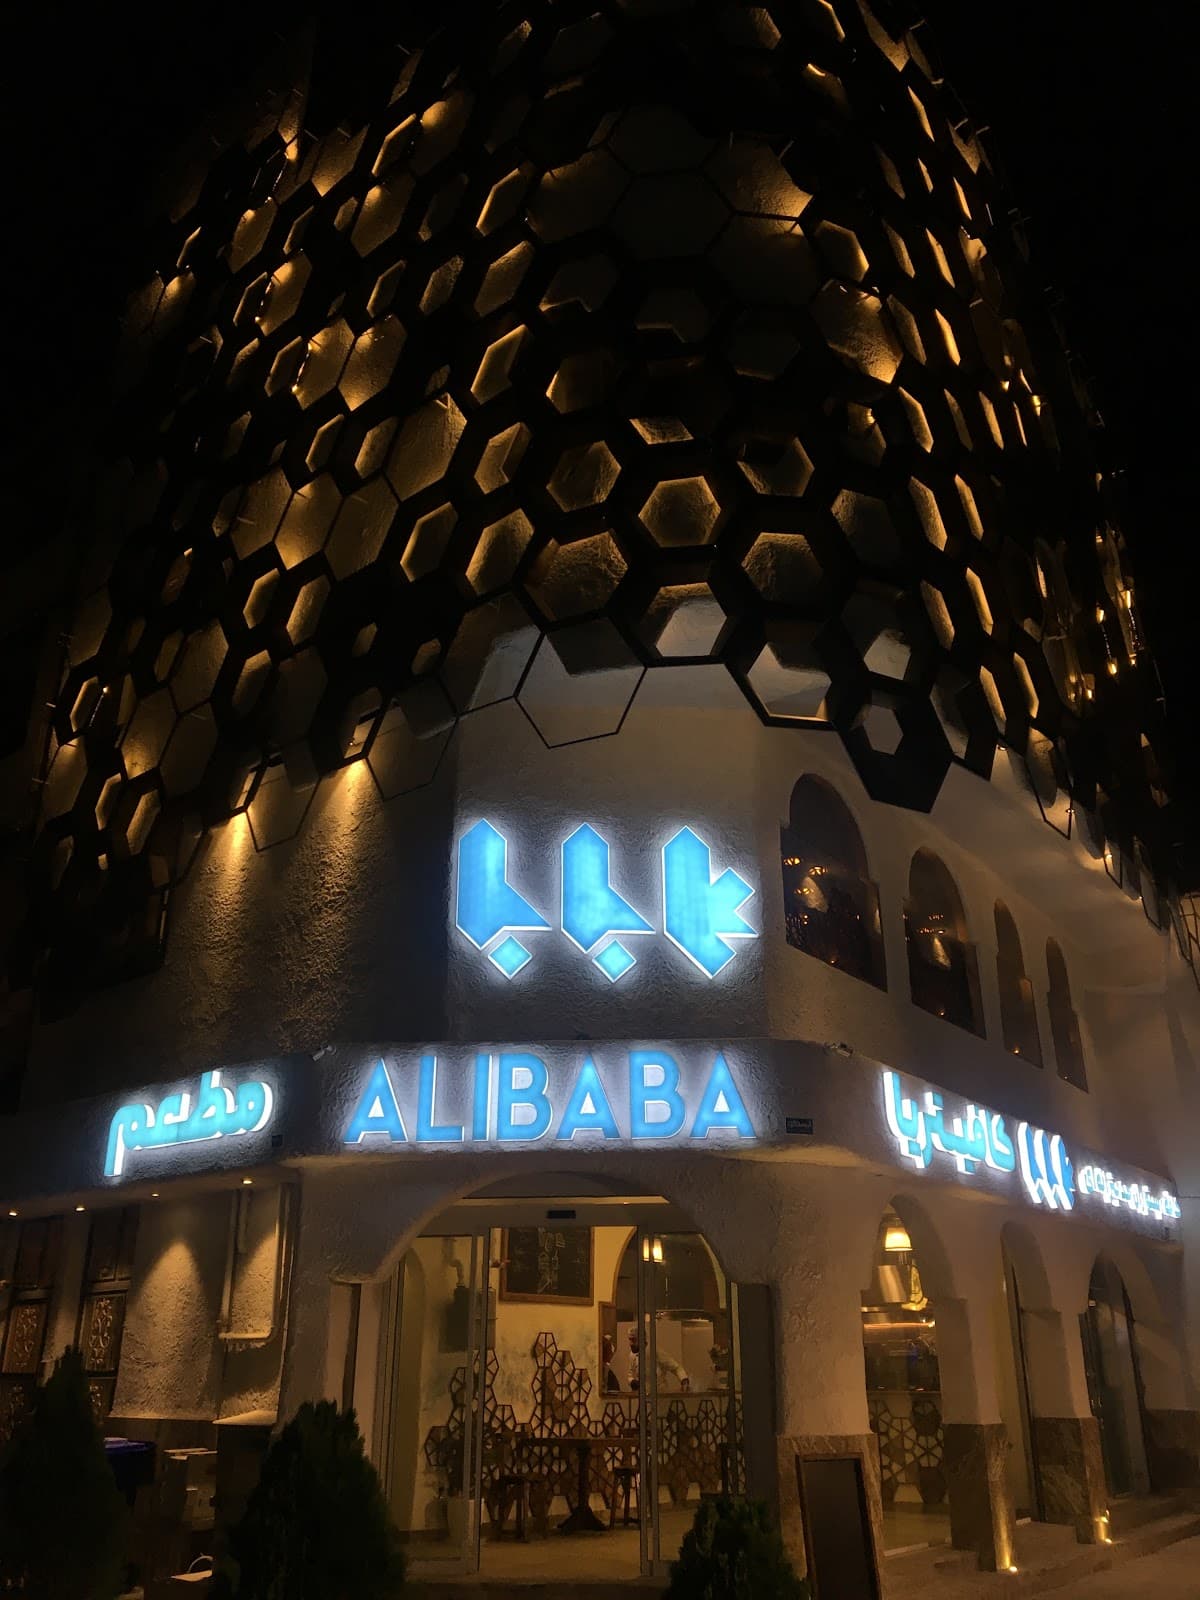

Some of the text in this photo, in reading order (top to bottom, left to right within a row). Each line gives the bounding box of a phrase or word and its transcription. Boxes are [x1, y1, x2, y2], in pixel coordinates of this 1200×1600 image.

[104, 1070, 273, 1177] مطعم
[343, 1050, 757, 1144] ALIBABA
[882, 1071, 1015, 1175] كافيتريا
